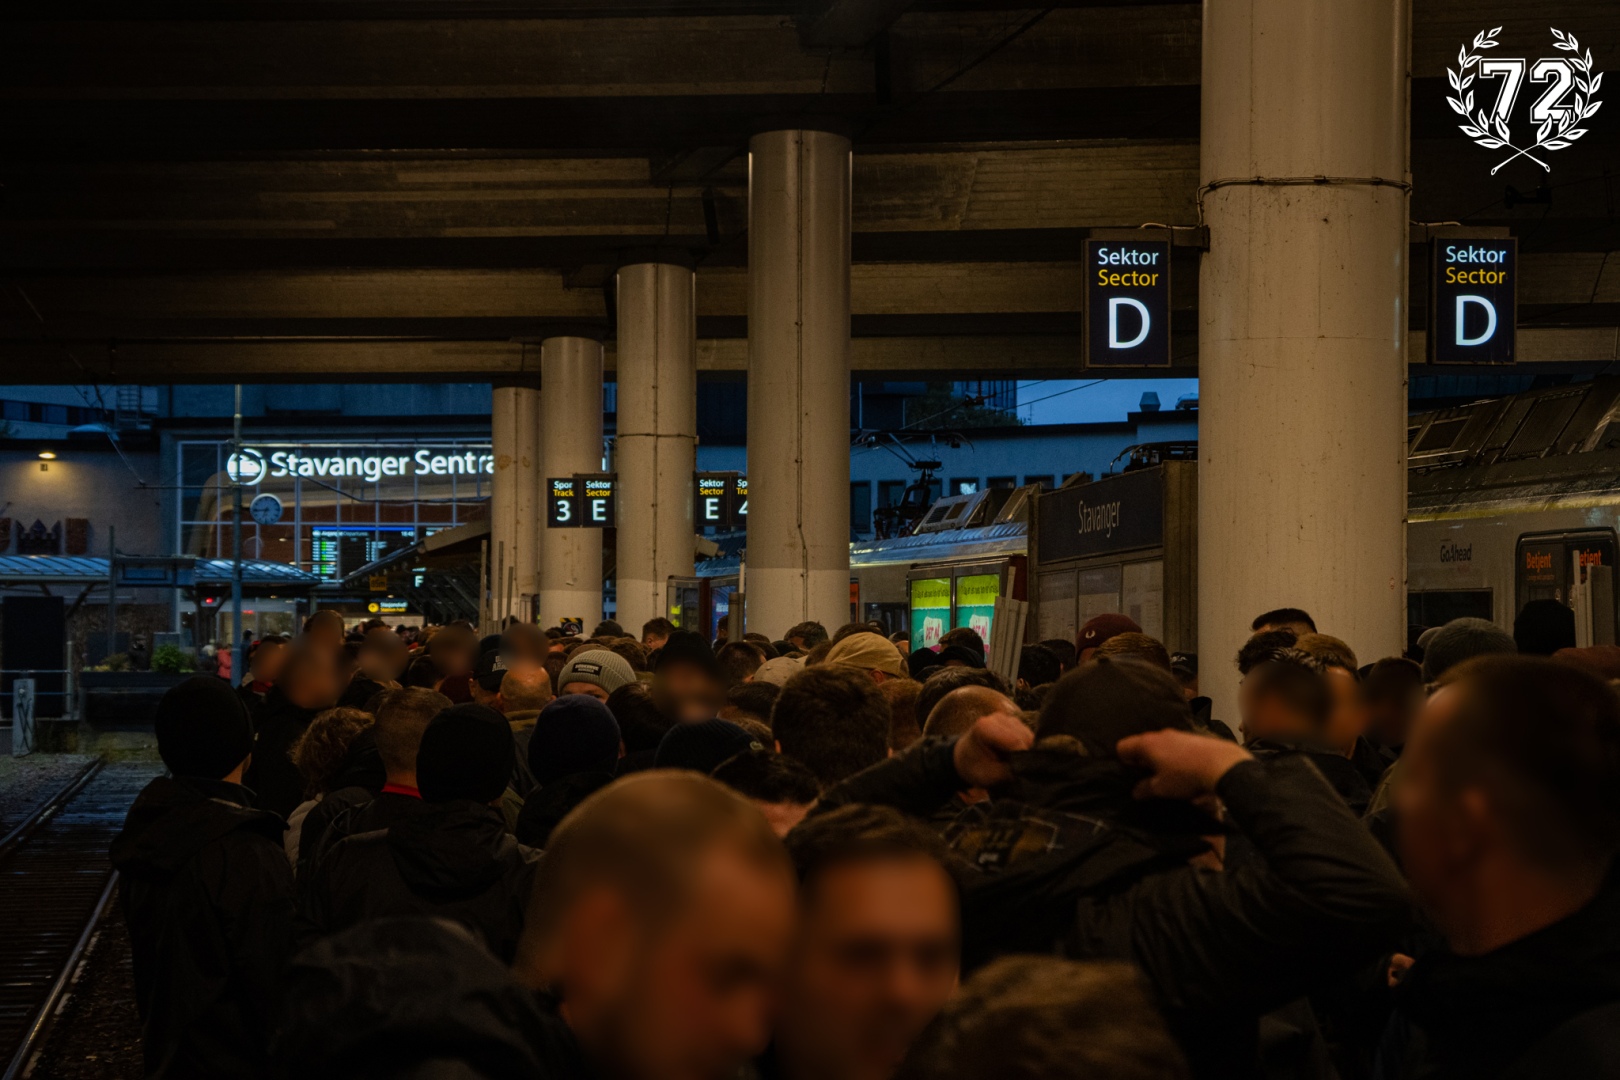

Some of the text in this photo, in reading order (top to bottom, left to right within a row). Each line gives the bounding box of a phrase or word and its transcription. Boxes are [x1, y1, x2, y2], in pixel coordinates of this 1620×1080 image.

[1097, 247, 1159, 265] Sektor
[1445, 245, 1507, 263] Sektor
[1097, 269, 1159, 286] Sector
[1445, 267, 1506, 284] Sector
[1108, 297, 1151, 349] D
[1455, 295, 1497, 346] D
[271, 450, 495, 482] Stavanger Sentra
[553, 481, 573, 490] Spor
[585, 481, 611, 489] Sektor
[699, 479, 725, 488] Sektor
[737, 480, 748, 489] Sp
[553, 489, 574, 497] Track
[586, 489, 611, 497] Sector
[556, 500, 571, 521] 3
[592, 500, 606, 521] E
[705, 498, 719, 520] E
[1078, 500, 1121, 538] Stavanger
[1526, 551, 1552, 572] Betjent
[1580, 549, 1602, 567] etjent
[414, 575, 424, 588] F
